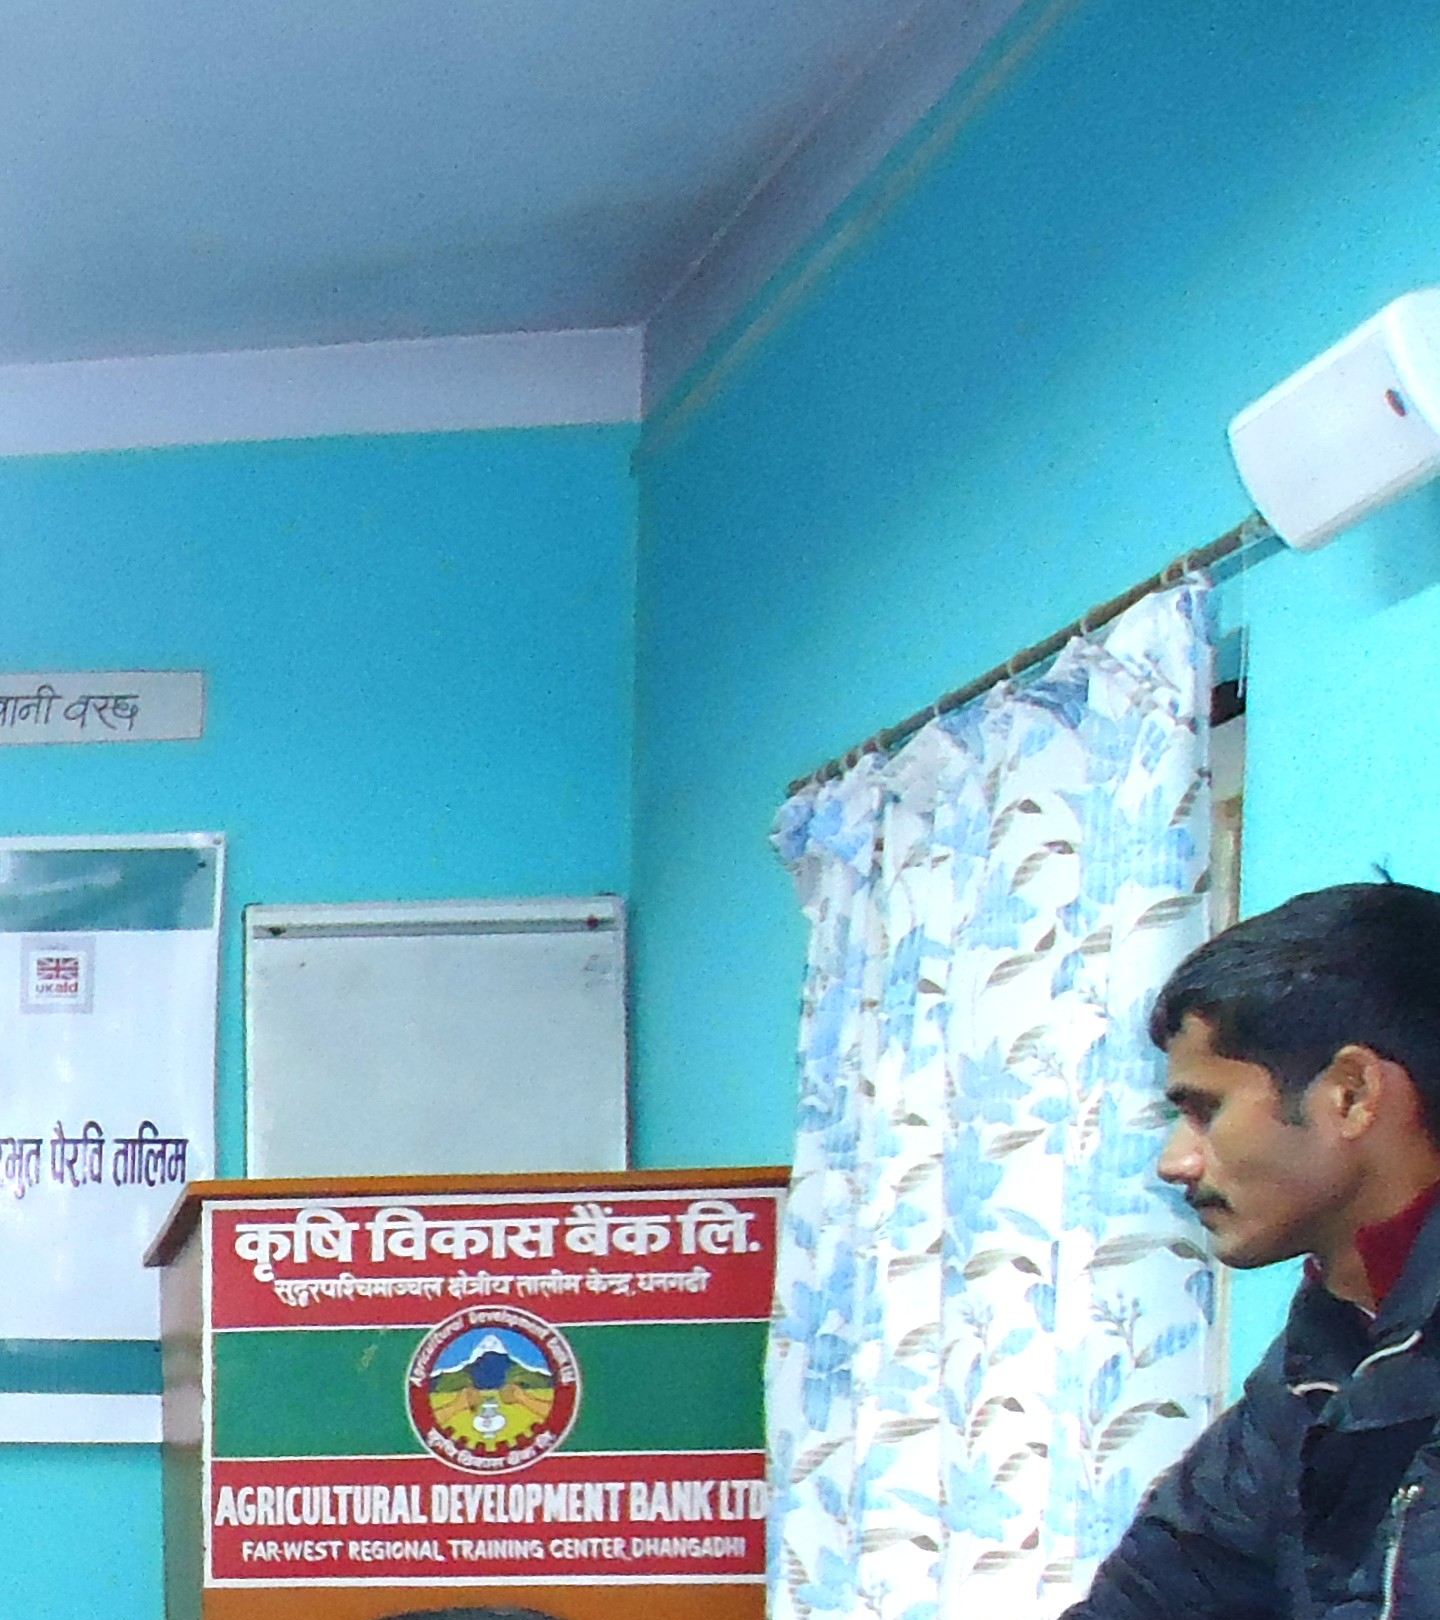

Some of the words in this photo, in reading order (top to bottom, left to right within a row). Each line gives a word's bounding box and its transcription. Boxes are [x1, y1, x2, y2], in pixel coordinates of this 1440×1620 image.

[112, 1120, 190, 1187] तालिम
[234, 1207, 360, 1282] कृषि
[365, 1207, 560, 1263] विकास
[564, 1202, 671, 1256] बैंक
[676, 1200, 762, 1255] लि.
[214, 1484, 428, 1526] AGRICULTURAL
[431, 1481, 625, 1525] DEVELOPMENT
[629, 1480, 717, 1522] BANK
[241, 1540, 344, 1562] FAR-WEST
[347, 1539, 447, 1562] REGIONAL
[447, 1538, 545, 1561] TRAINING
[631, 1535, 746, 1559] DHANGADHI
